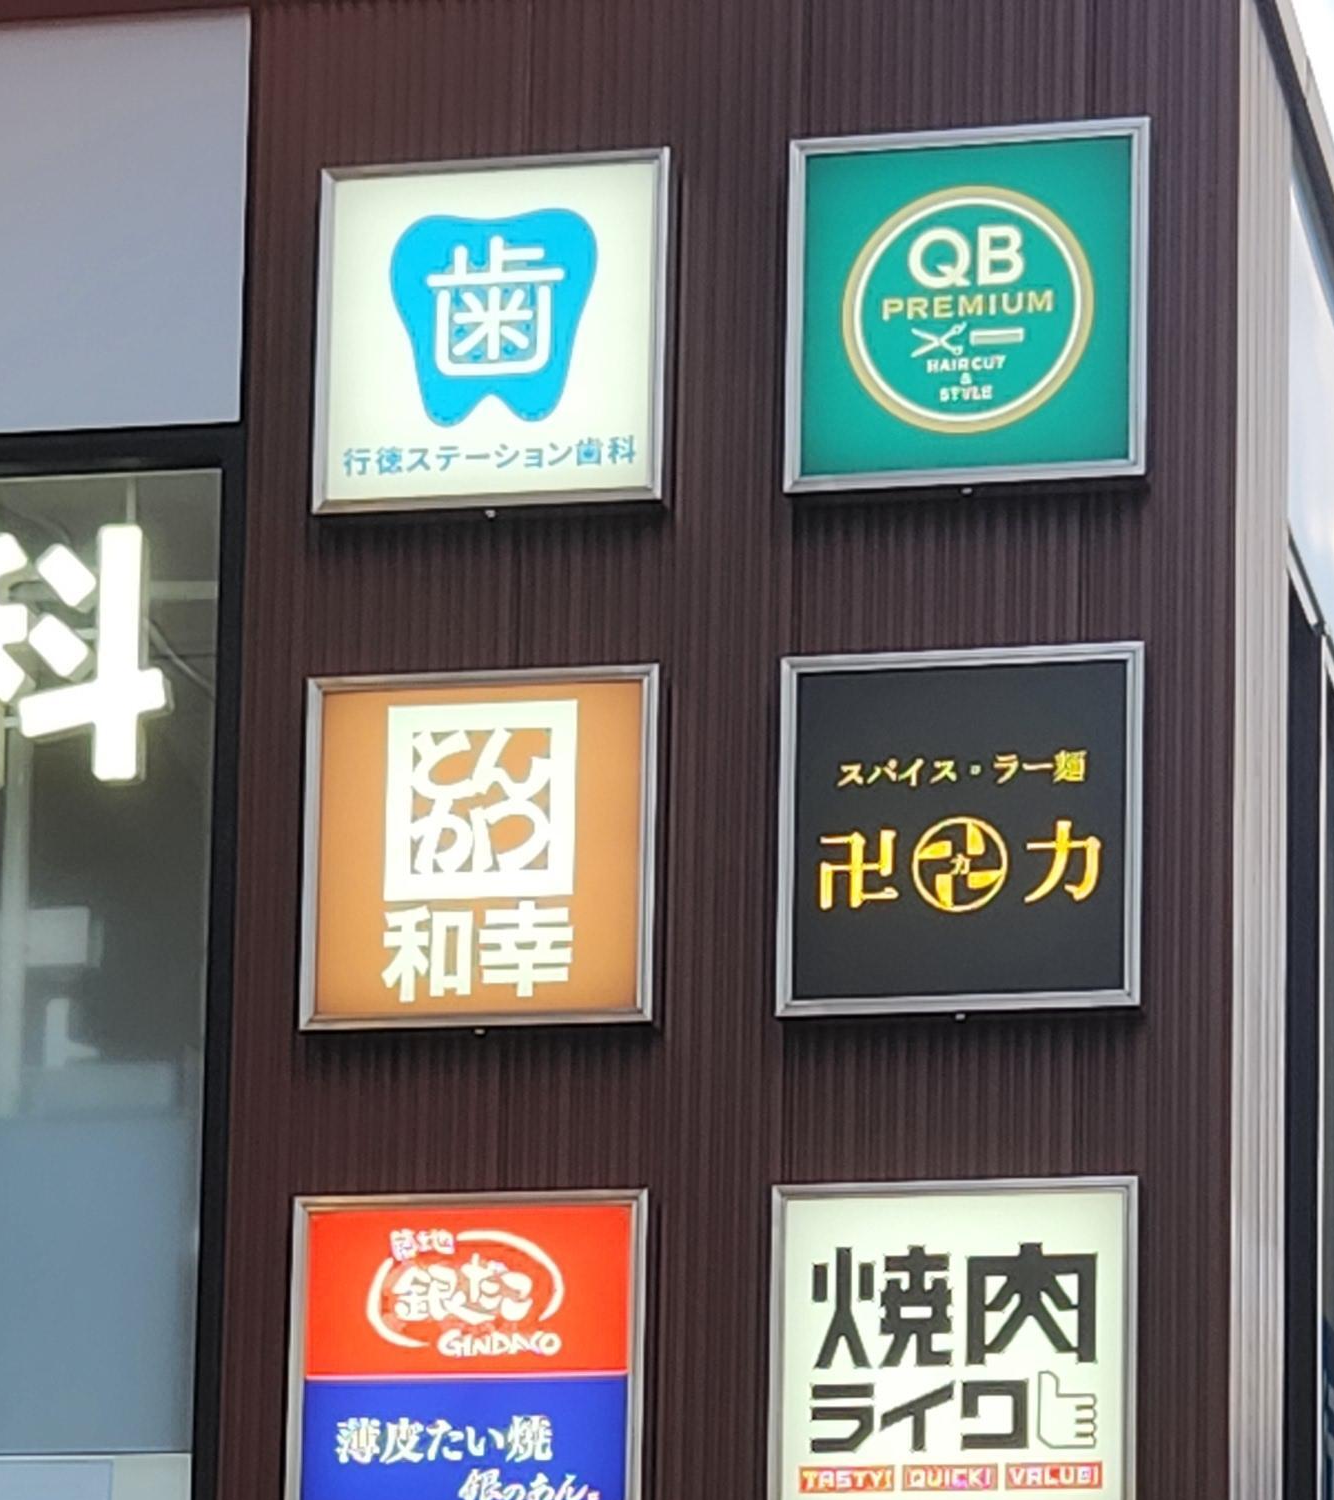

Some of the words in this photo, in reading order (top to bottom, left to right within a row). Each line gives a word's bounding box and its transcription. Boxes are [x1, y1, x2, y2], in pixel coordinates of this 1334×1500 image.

[908, 224, 1025, 289] QB
[427, 235, 565, 377] 歯
[882, 289, 1054, 321] PREMIUM
[926, 355, 1007, 373] HAIRCUT
[938, 385, 994, 402] STYLE
[343, 435, 637, 477] 行徳ステーション歯科
[837, 749, 1088, 788] スパイス・ラー麺
[381, 900, 574, 1003] 和幸
[391, 1252, 534, 1326] 銀だこ
[811, 1241, 1098, 1369] 焼肉
[437, 1328, 562, 1358] GINDACO
[810, 1378, 1029, 1453] ライク
[336, 1415, 554, 1465] 薄皮たい焼
[801, 1469, 893, 1490] TASTY!
[909, 1467, 993, 1489] QUICK!
